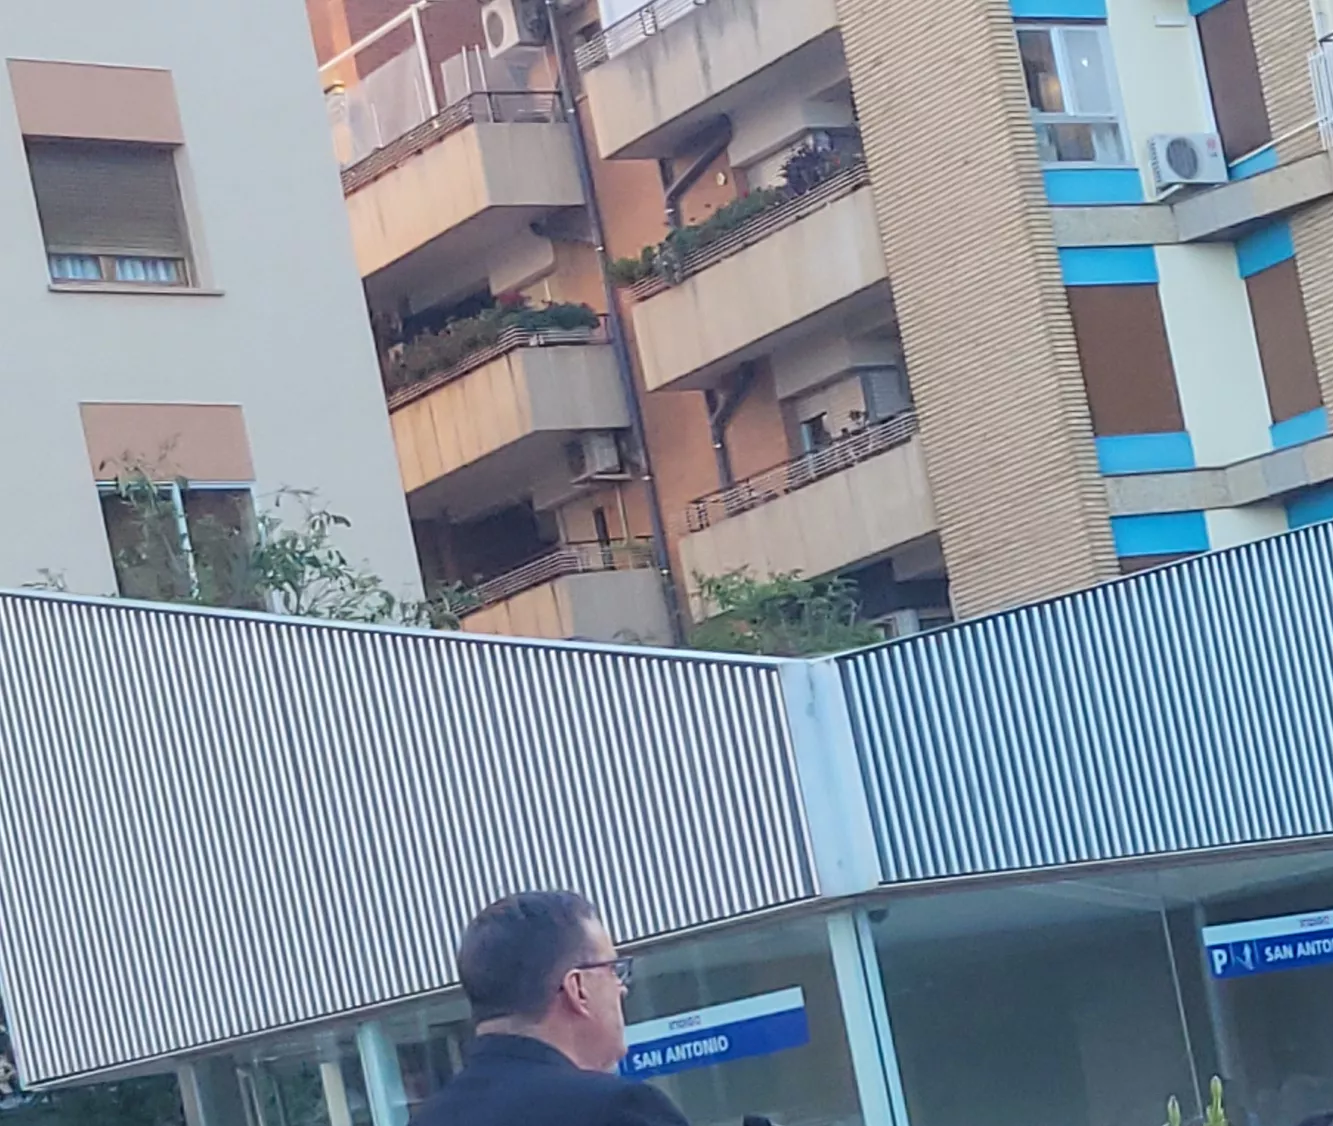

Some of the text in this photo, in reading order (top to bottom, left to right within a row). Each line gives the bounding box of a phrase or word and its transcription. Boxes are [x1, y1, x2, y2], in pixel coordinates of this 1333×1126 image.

[1211, 948, 1228, 975] P
[1264, 945, 1294, 963] SAN
[632, 1035, 729, 1071] SAN ANTONIO
